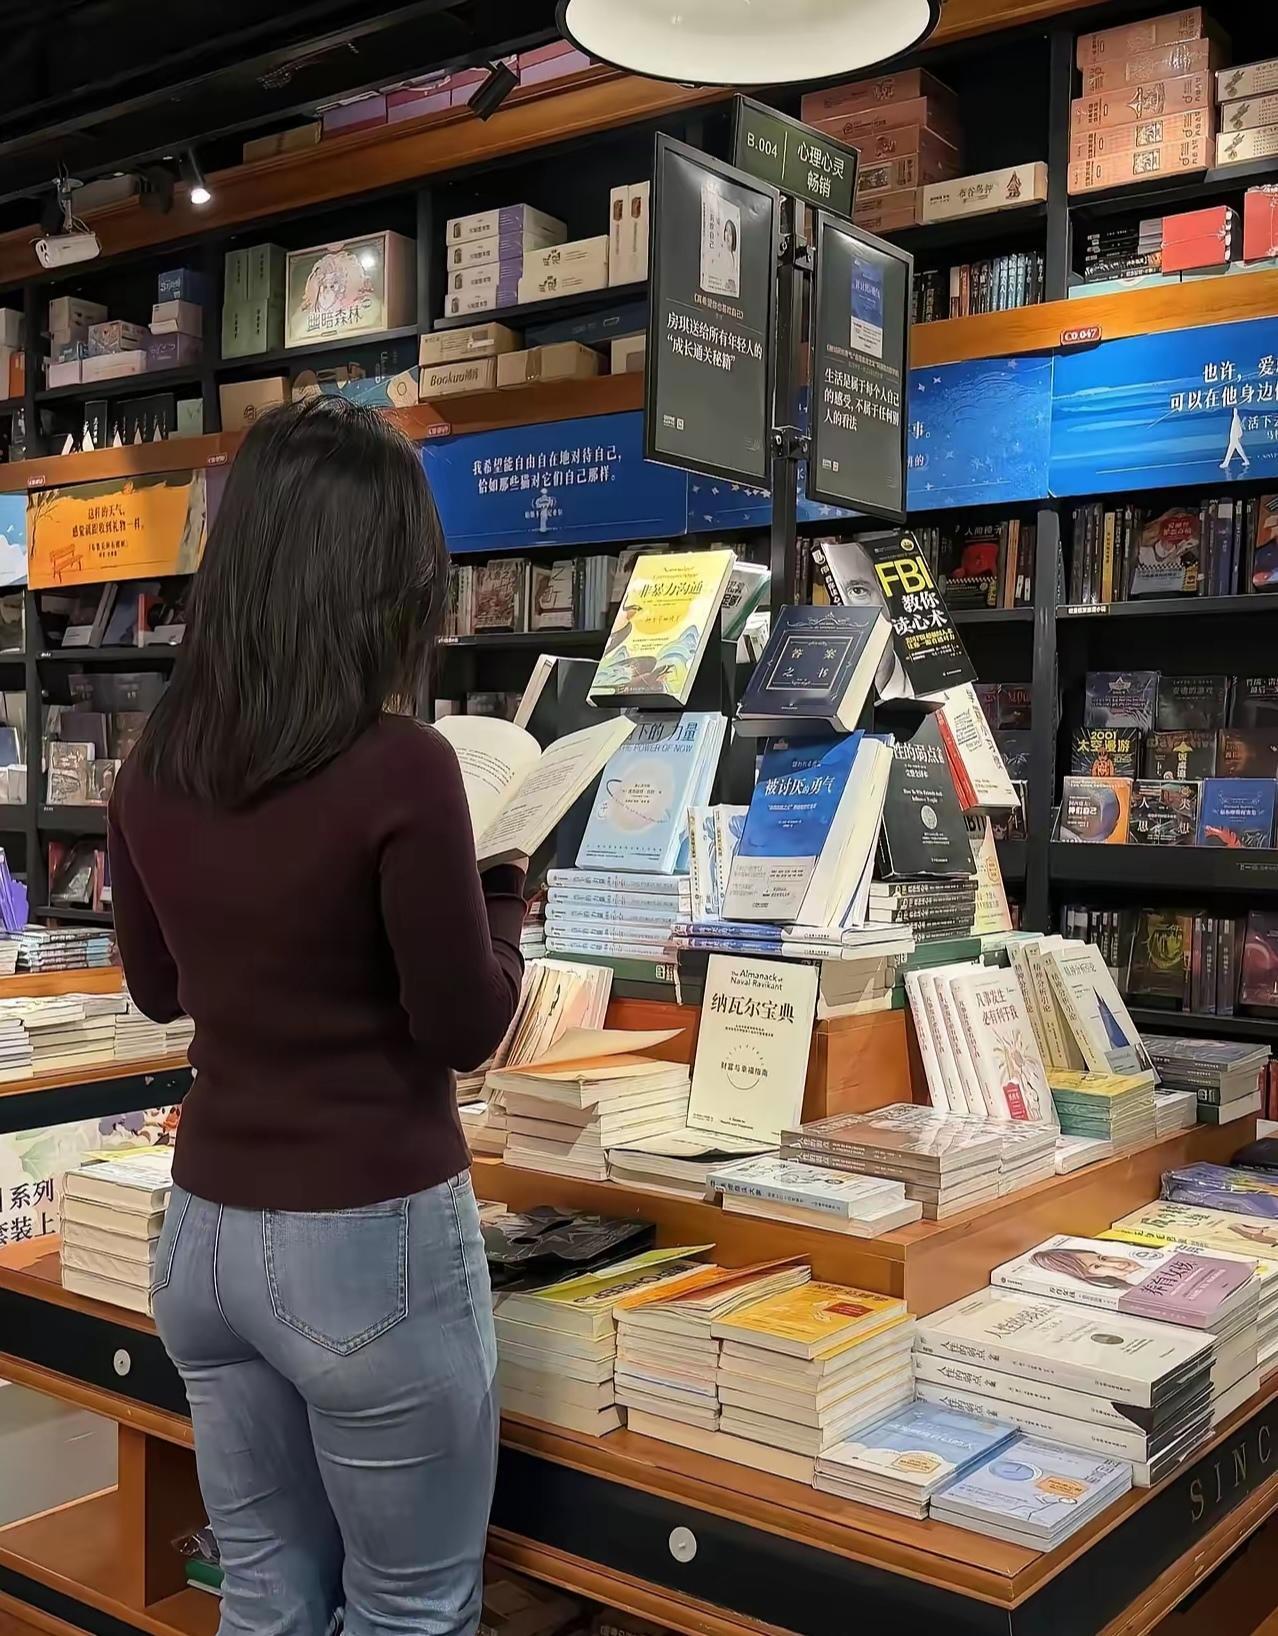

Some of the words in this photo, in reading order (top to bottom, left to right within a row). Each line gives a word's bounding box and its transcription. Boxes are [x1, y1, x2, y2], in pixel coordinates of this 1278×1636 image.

[747, 132, 778, 158] B.004
[797, 142, 845, 180] 心理心灵
[807, 169, 832, 198] 畅销
[667, 311, 763, 360] 房琪送给所有年轻人的
[1258, 355, 1278, 377] 爱
[824, 367, 900, 408] 生活是属于每个人自己
[1170, 381, 1278, 412] 可以在他身边
[824, 408, 858, 432] 人的看法
[640, 581, 703, 598] 非暴力沟通
[874, 556, 934, 598] FBI
[902, 591, 940, 613] 教你
[891, 609, 948, 636] 读心术
[629, 720, 698, 741] 下的力量
[1090, 731, 1117, 740] 2001
[1077, 739, 1130, 752] 太空漫游
[765, 776, 835, 796] 被讨厌的勇气
[730, 977, 751, 987] Naval
[752, 979, 783, 991] Ravikant
[739, 969, 777, 982] Almanack
[710, 992, 795, 1024] 纳瓦尔宝典
[0, 1178, 55, 1214] 系列
